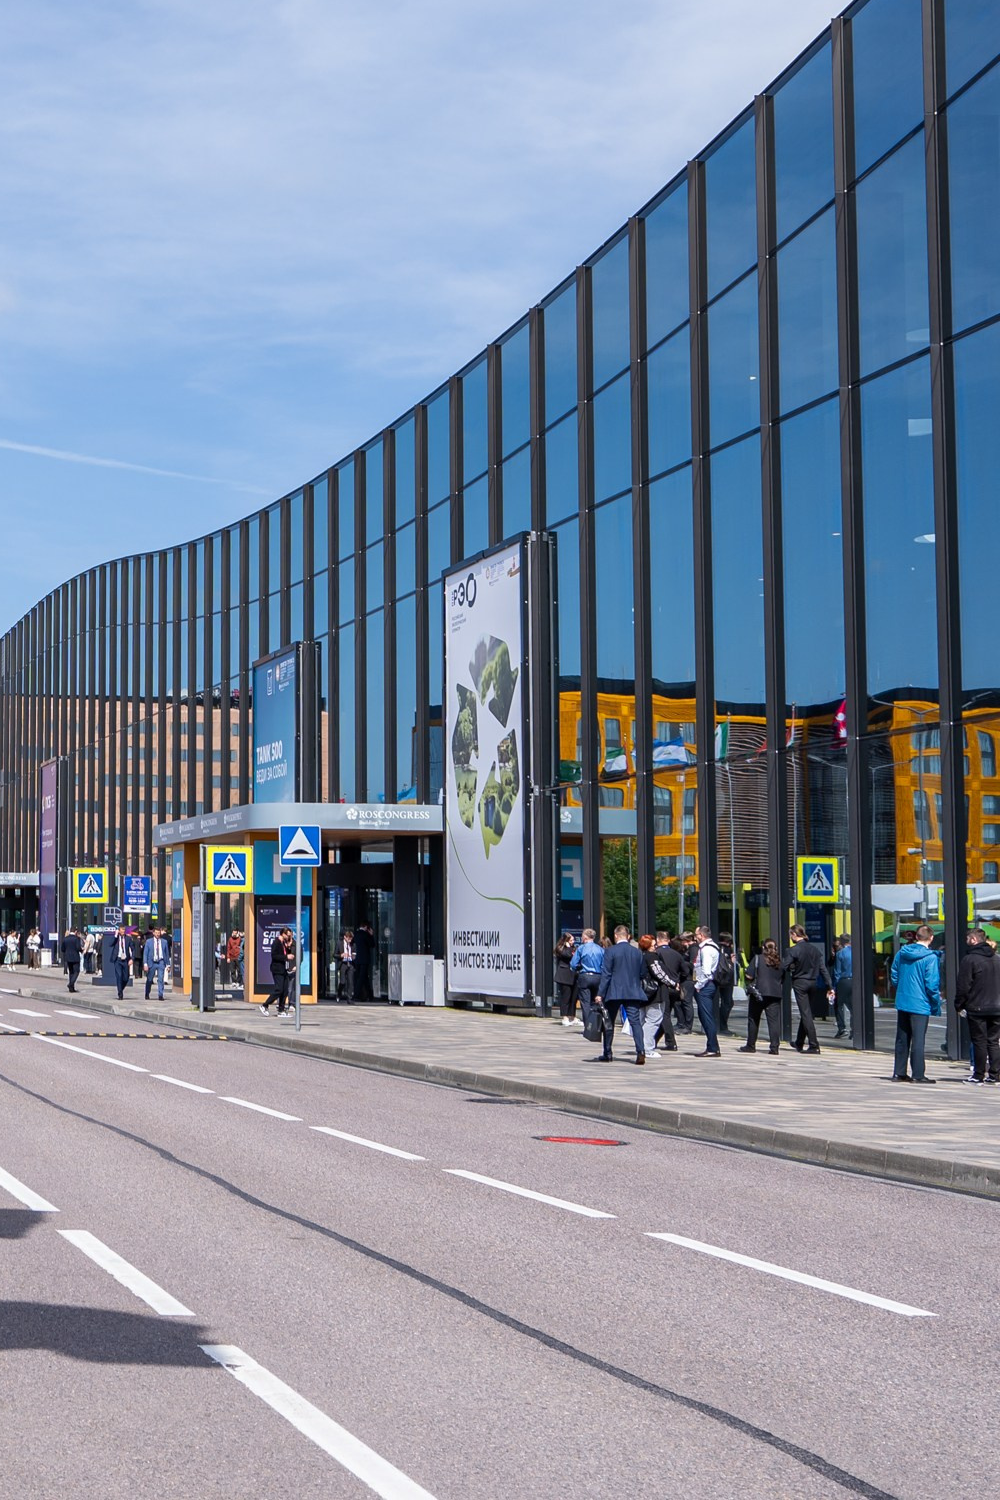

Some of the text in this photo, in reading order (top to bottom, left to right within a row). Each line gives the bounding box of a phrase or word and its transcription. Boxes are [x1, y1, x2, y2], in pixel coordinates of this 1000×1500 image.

[453, 573, 477, 608] РЭО
[256, 739, 283, 765] TANK 500
[359, 810, 430, 820] ROSCONGRESS
[453, 930, 500, 949] ИНВЕСТИЦИИ
[453, 952, 521, 973] В ЧИСТОЕ БУДУЩЕЕ
